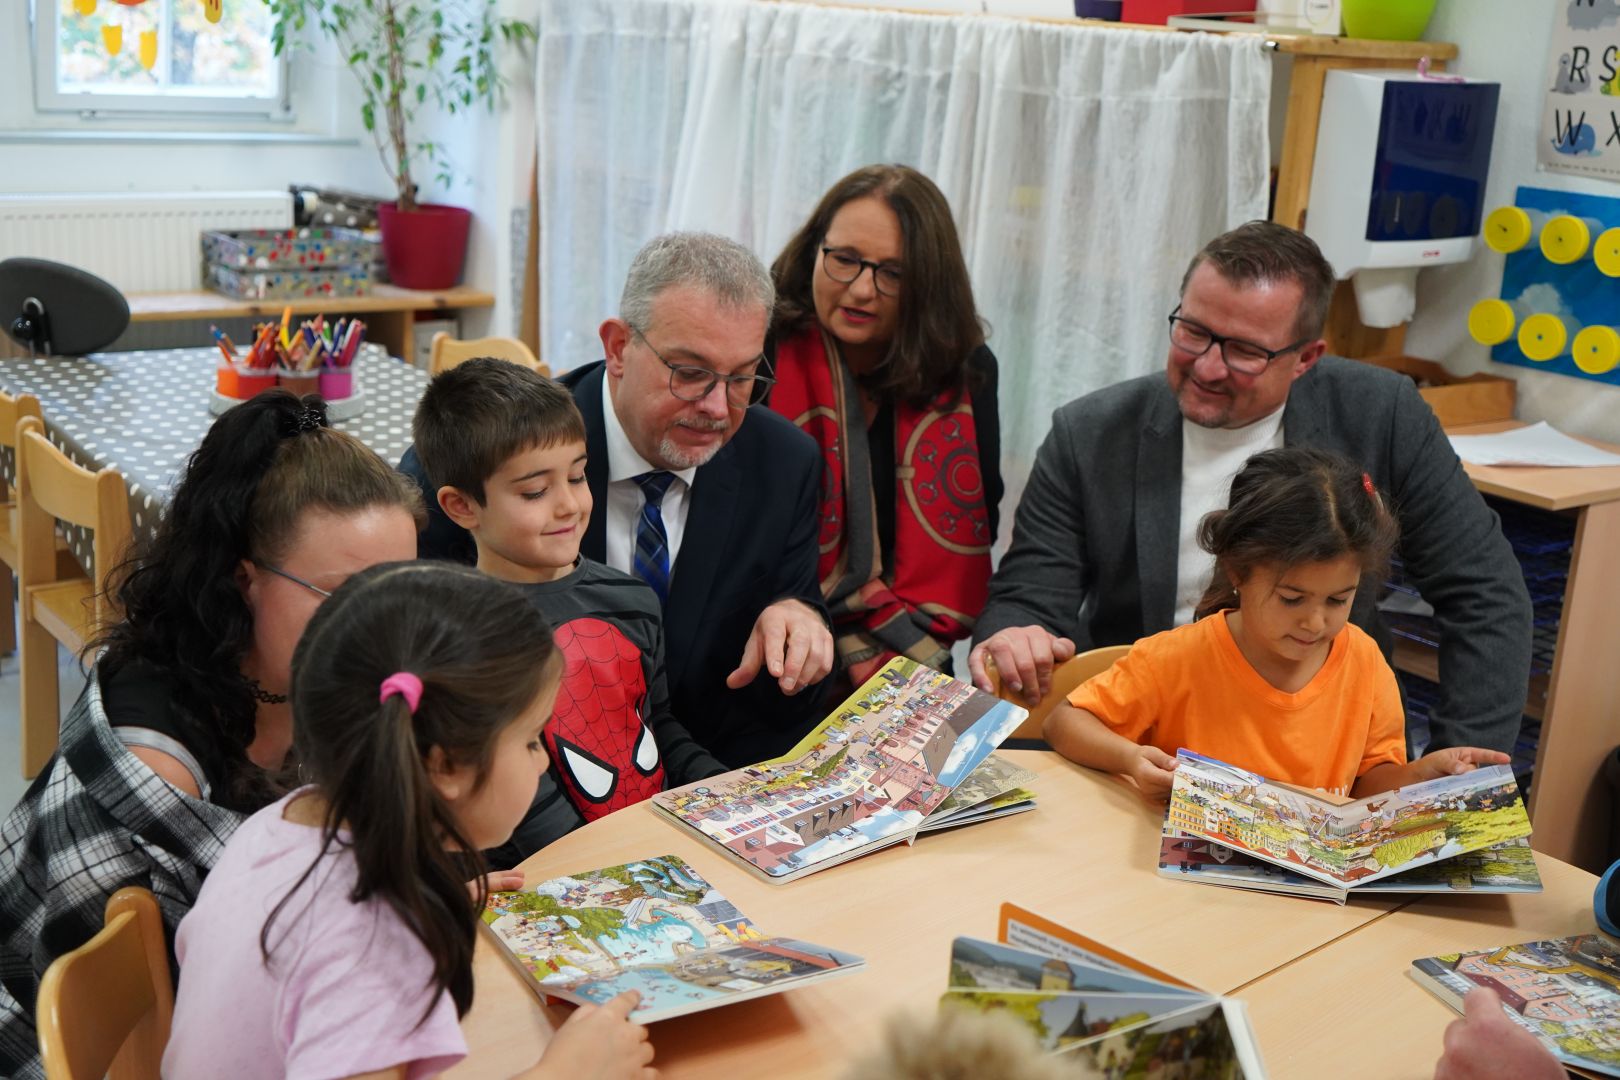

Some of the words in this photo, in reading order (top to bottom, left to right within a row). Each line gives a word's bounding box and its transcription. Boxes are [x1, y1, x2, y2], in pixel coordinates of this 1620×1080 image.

[1569, 46, 1590, 83] R
[1599, 45, 1618, 82] S
[1555, 109, 1586, 147] W
